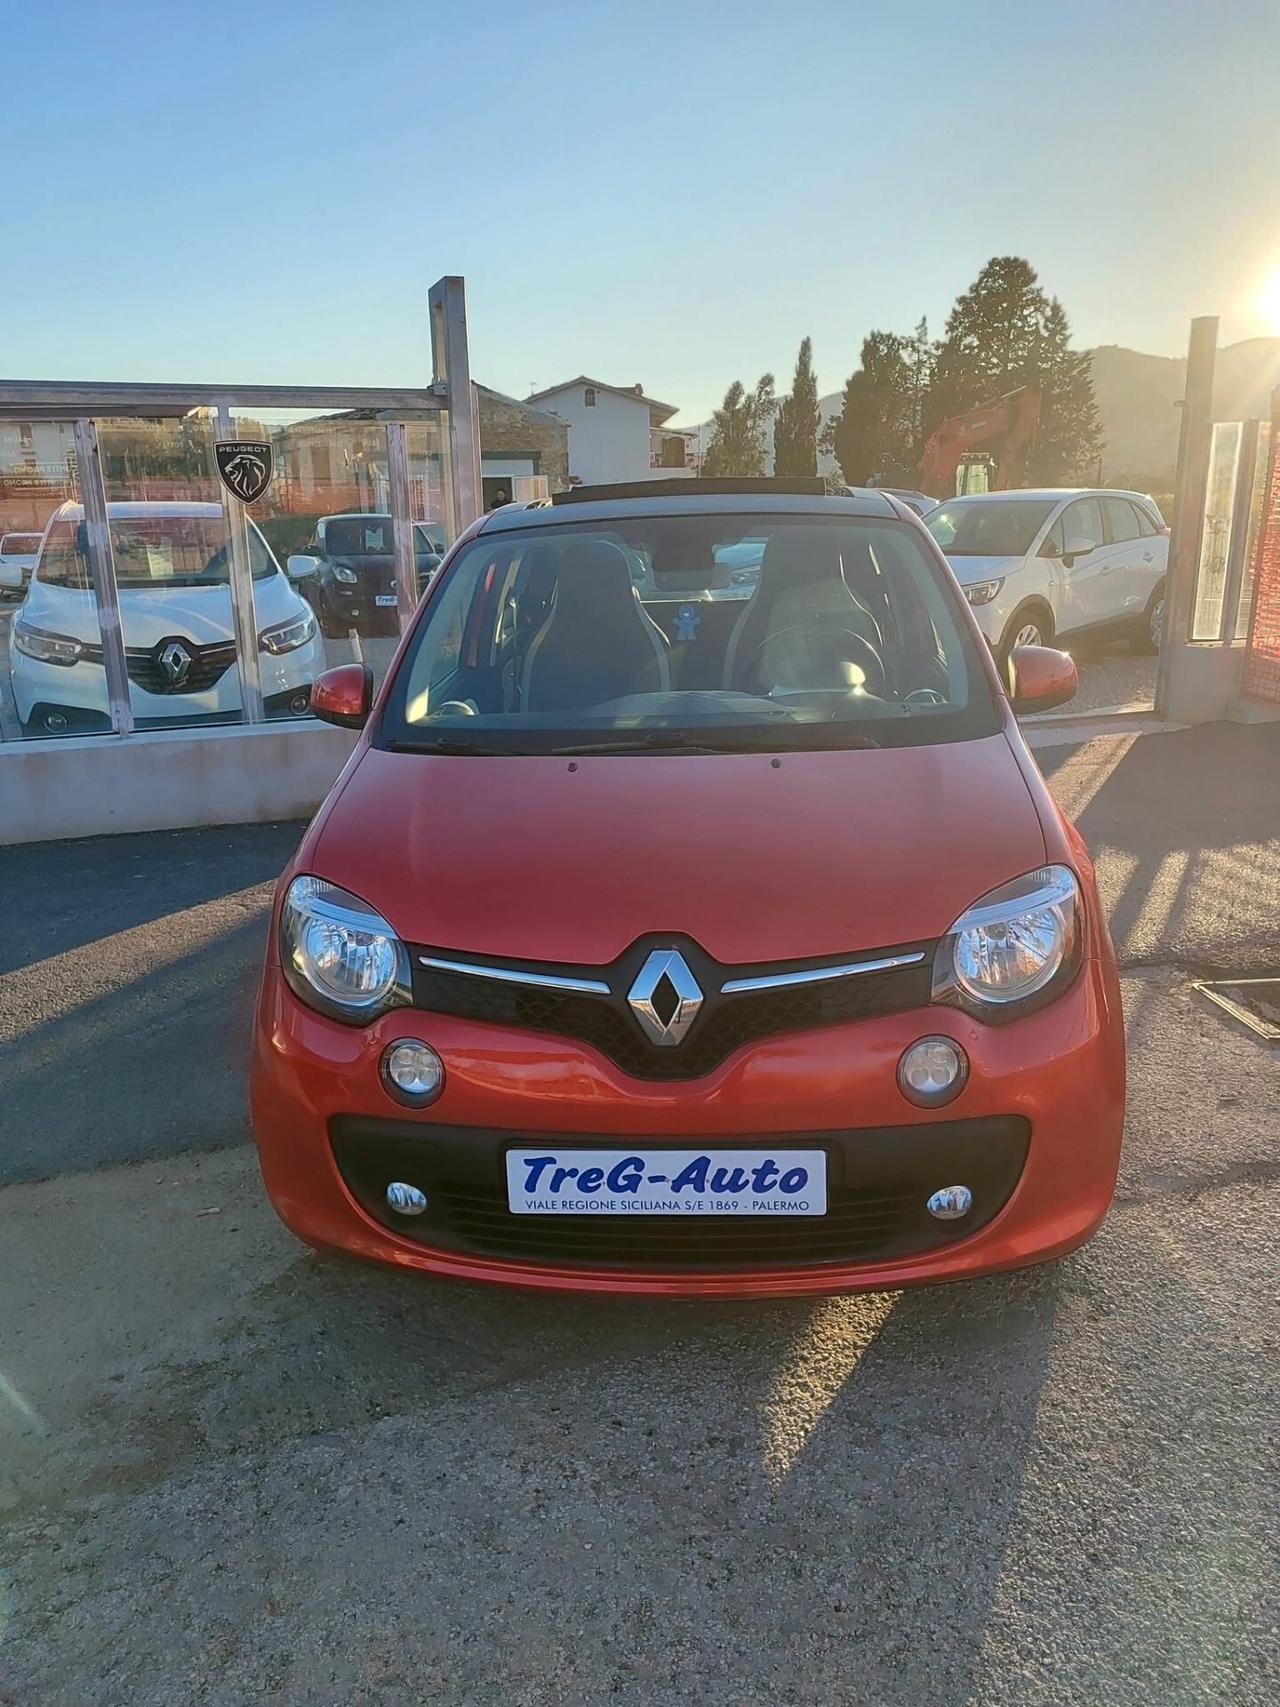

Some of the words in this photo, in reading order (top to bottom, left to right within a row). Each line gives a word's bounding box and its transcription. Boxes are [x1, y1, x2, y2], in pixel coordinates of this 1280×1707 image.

[523, 1156, 809, 1194] TreG-Auto
[525, 1200, 557, 1210] VIALE
[562, 1200, 616, 1210] REGIONE
[621, 1200, 680, 1210] SICILIANA
[685, 1200, 704, 1211] S/E
[709, 1200, 739, 1211] 1869
[752, 1200, 810, 1211] PALERMO
